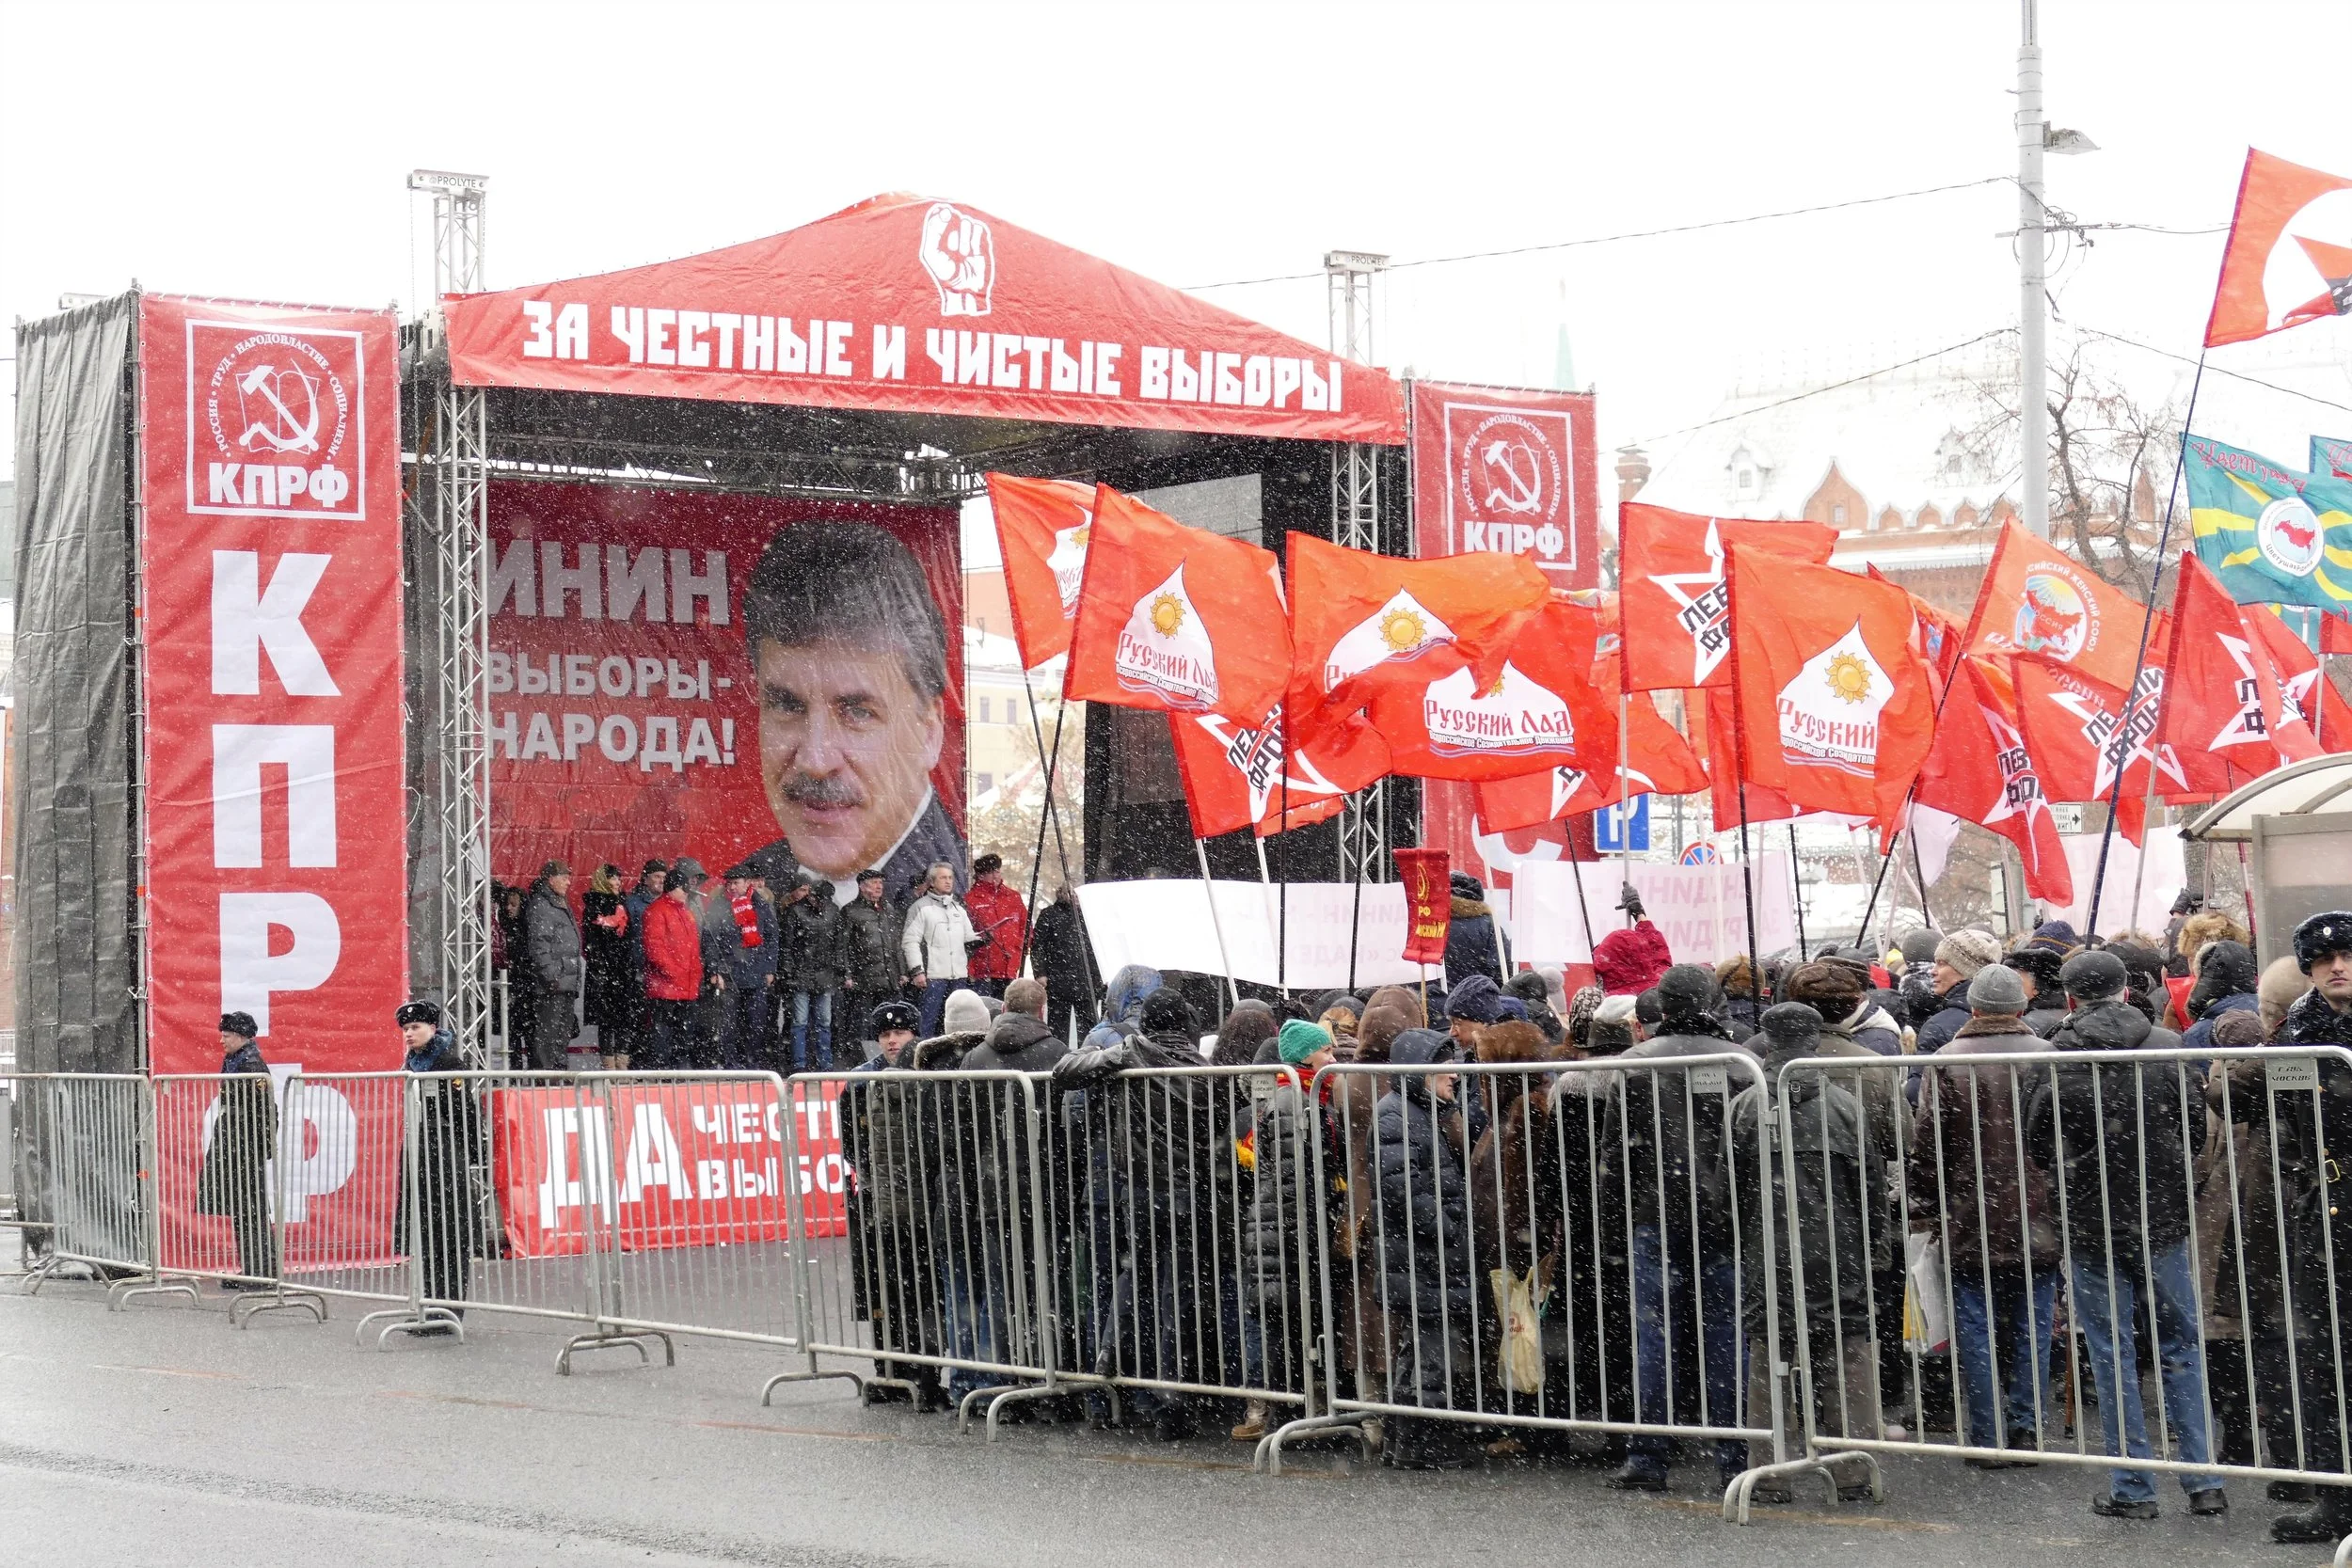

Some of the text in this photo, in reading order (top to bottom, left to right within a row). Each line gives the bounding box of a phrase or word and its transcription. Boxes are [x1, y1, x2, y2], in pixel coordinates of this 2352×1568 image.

[437, 175, 476, 188] PROLYTE
[523, 300, 589, 360] ЗА
[611, 306, 853, 376] ЧЕСТНЫЕ
[872, 324, 906, 380] И
[927, 328, 1122, 396] ЧИСТЫЕ
[1139, 345, 1342, 412] ВЫБОРЫ
[208, 333, 348, 457] РОССИЯ ТРУД НАРОДОВЛАСТИЕ СОЦИАЛИЗМ
[209, 462, 349, 508] КПРФ
[1464, 520, 1565, 560] КПРФ
[2032, 606, 2064, 633] ОССИЯ
[2070, 574, 2101, 617] ЖЕНСКИЙ
[2086, 620, 2101, 653] СОЮЗ
[1425, 699, 1515, 736] Русский
[483, 711, 735, 773] НАРОДА!
[692, 1101, 845, 1145] ЧЕСТ
[540, 1102, 692, 1229] ДА
[698, 1152, 851, 1201] ВЫБО
